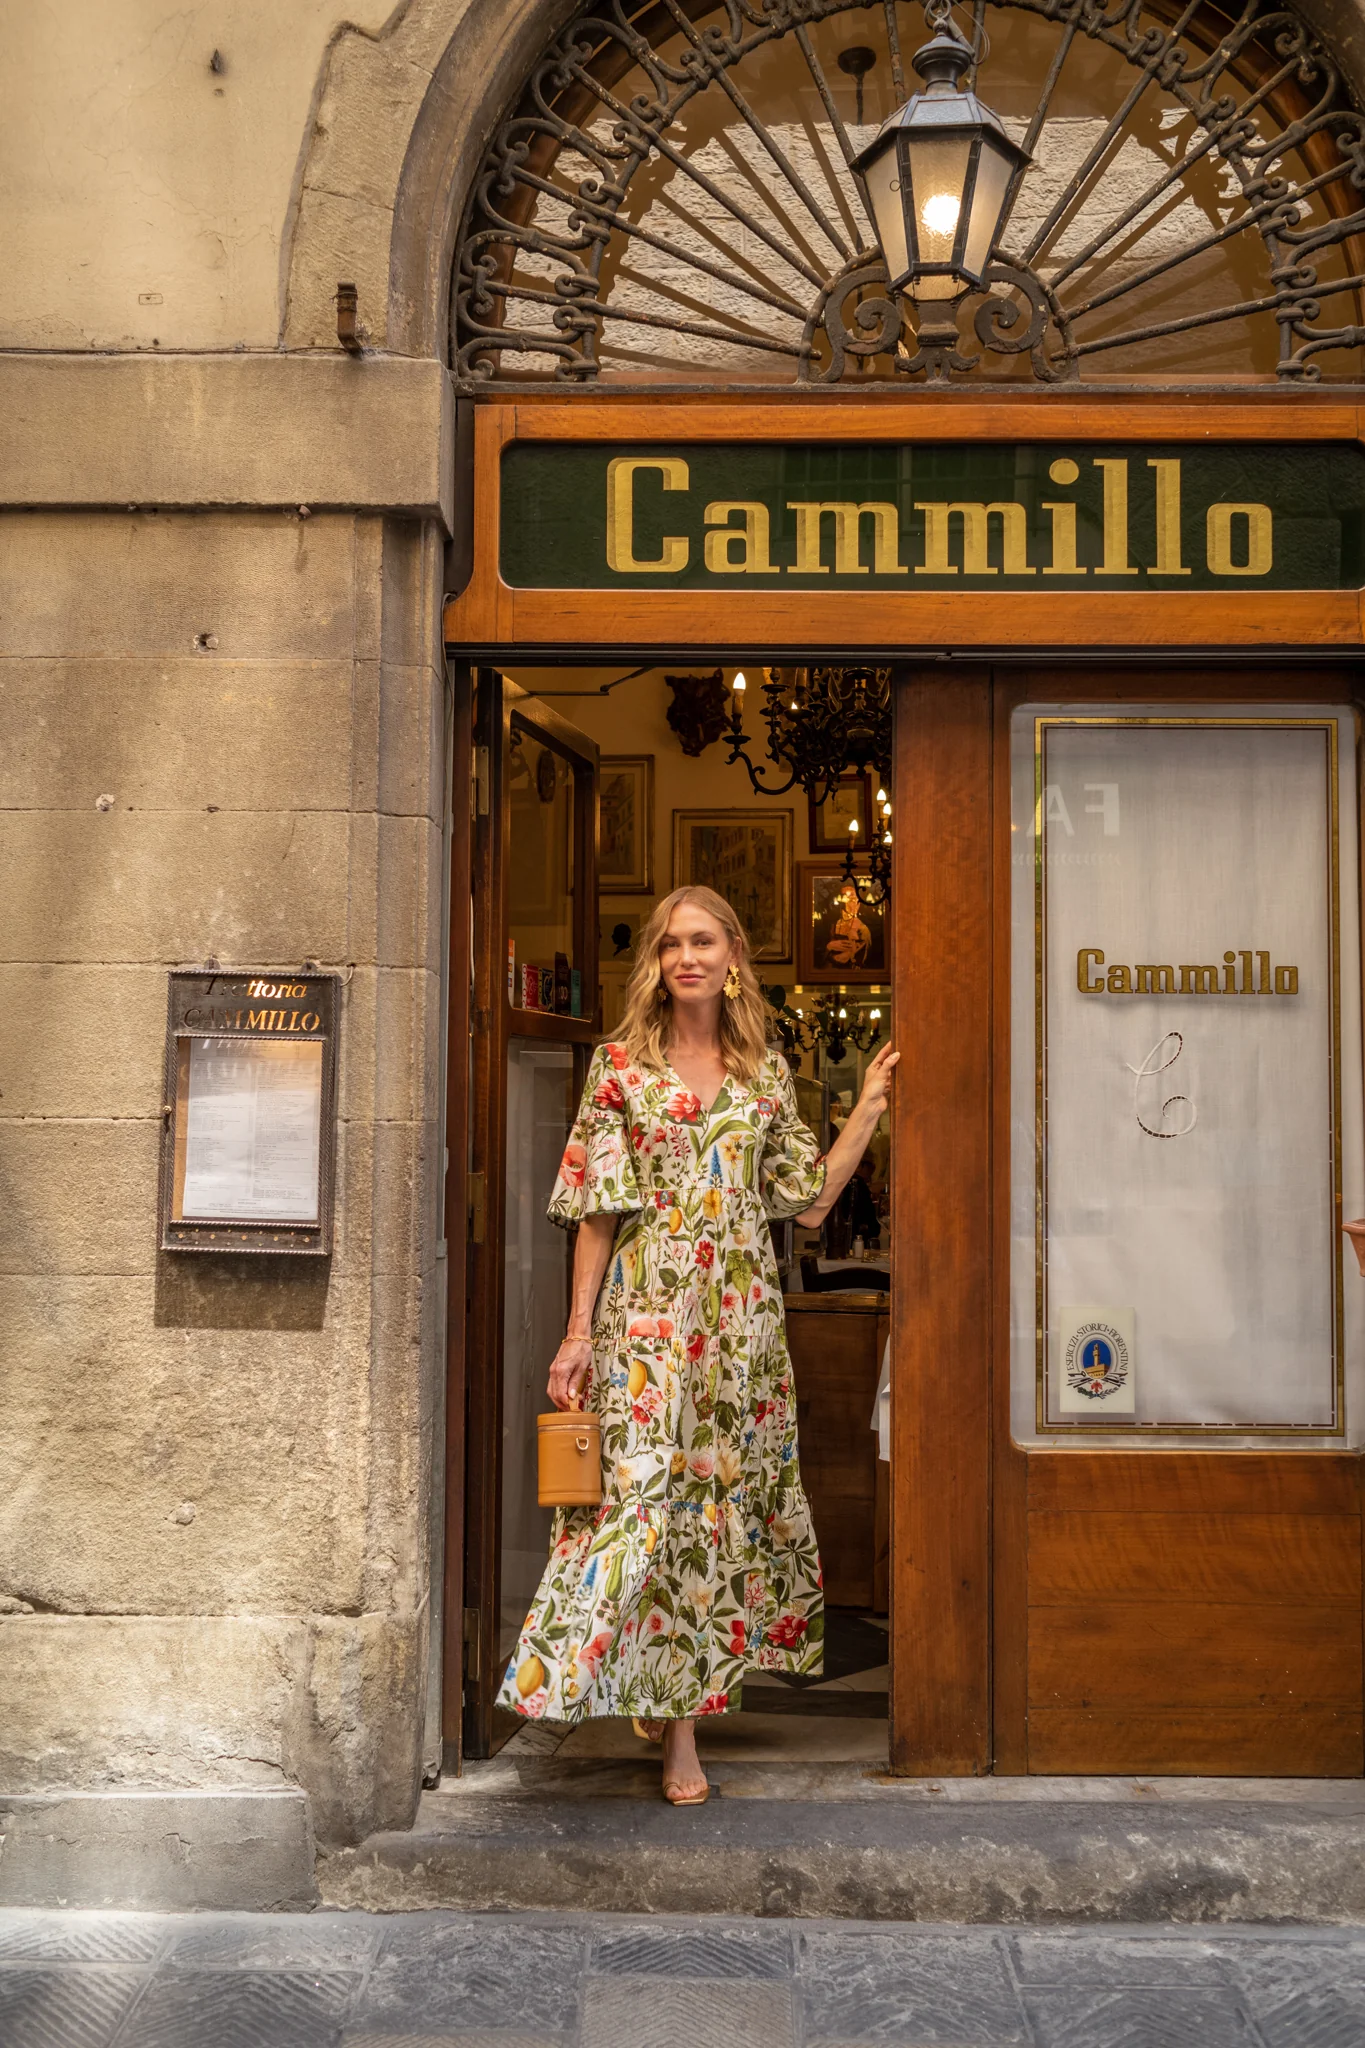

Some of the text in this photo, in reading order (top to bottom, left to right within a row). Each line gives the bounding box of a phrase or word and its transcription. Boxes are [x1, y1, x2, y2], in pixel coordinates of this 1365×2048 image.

[606, 456, 1274, 576] Cammillo
[202, 976, 308, 1000] Trattoria
[1076, 948, 1299, 995] Cammillo
[183, 1007, 321, 1032] CAMMILLO
[1065, 1322, 1128, 1371] ESERCIZI STORICI FIORENTINI
